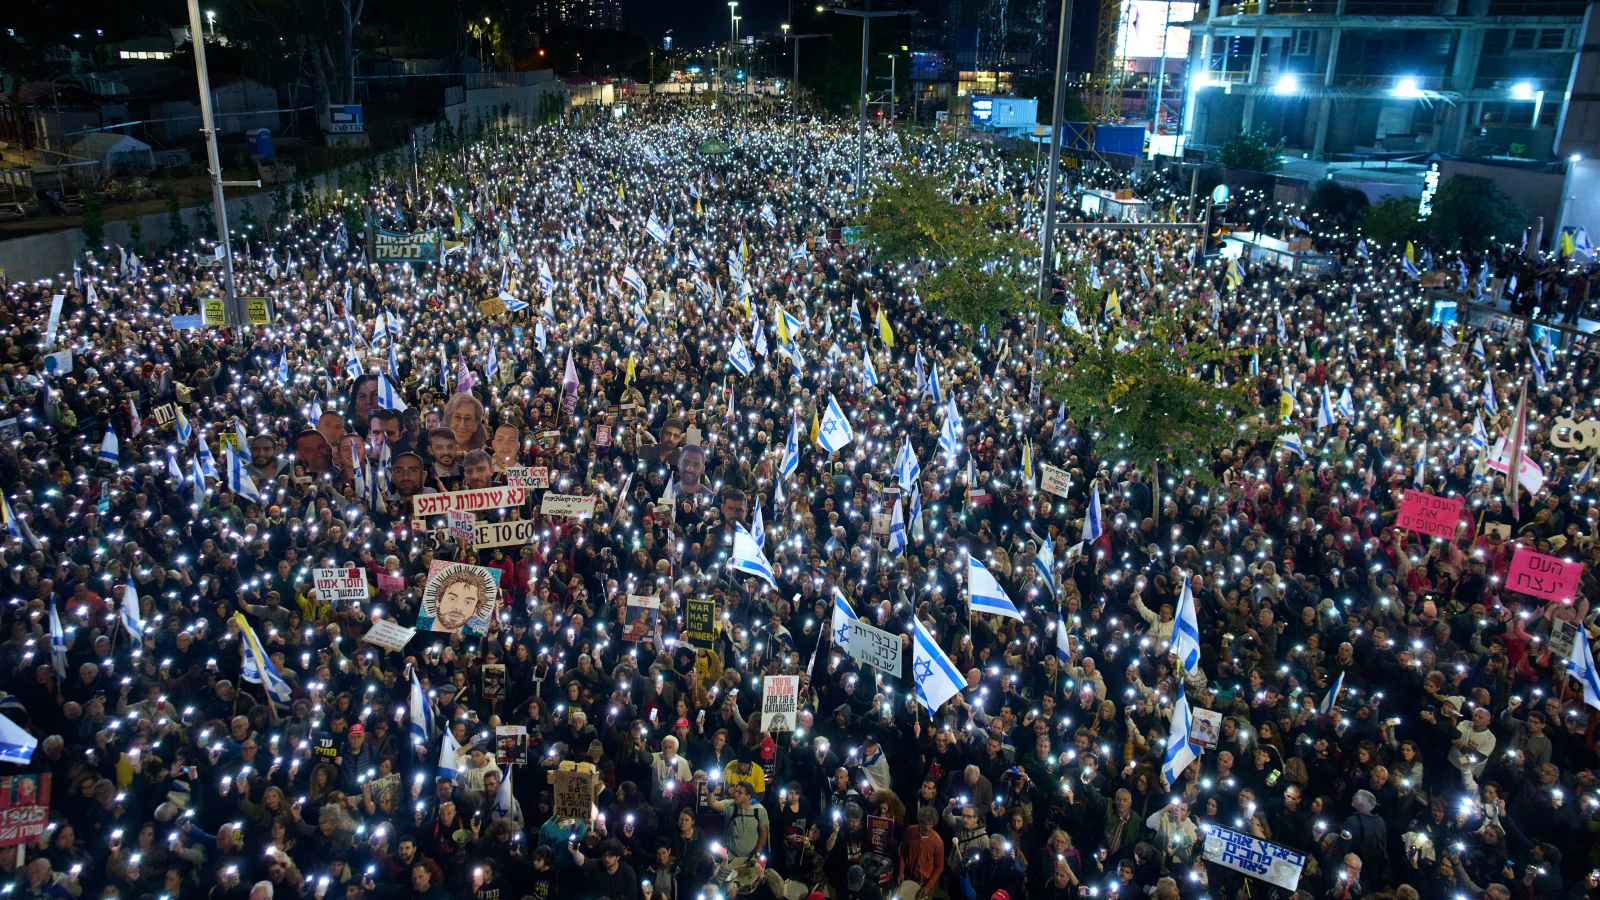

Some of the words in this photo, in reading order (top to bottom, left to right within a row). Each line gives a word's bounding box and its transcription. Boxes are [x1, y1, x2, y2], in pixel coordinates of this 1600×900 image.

[376, 244, 421, 258] לנשק
[418, 494, 451, 514] לרגע
[455, 491, 503, 510] שוכחות
[1405, 491, 1430, 506] דורש
[1433, 500, 1456, 512] העם
[1417, 507, 1438, 519] את
[493, 525, 512, 542] TO
[516, 521, 534, 540] GO
[1402, 516, 1452, 537] החטופים
[1529, 556, 1563, 576] העם
[321, 569, 334, 577] לנו
[317, 579, 339, 590] אמון
[341, 579, 364, 588] חוסר
[1517, 573, 1563, 594] ינצח
[321, 589, 333, 599] בך
[335, 588, 365, 598] מתמשך
[690, 602, 709, 612] WAR
[690, 613, 708, 622] HAS
[690, 622, 703, 630] NO
[688, 631, 715, 641] WINNERS
[854, 624, 898, 652] נבצרות
[871, 642, 897, 661] לפני
[772, 677, 792, 686] YOU'RE
[768, 686, 775, 696] TO
[776, 686, 795, 695] BLAME
[766, 695, 777, 703] FOR
[764, 704, 795, 713] QATARGATE
[320, 739, 333, 747] עד
[314, 746, 337, 757] מתי?
[1258, 840, 1303, 867] בארץ
[1222, 852, 1268, 875] לאורח
